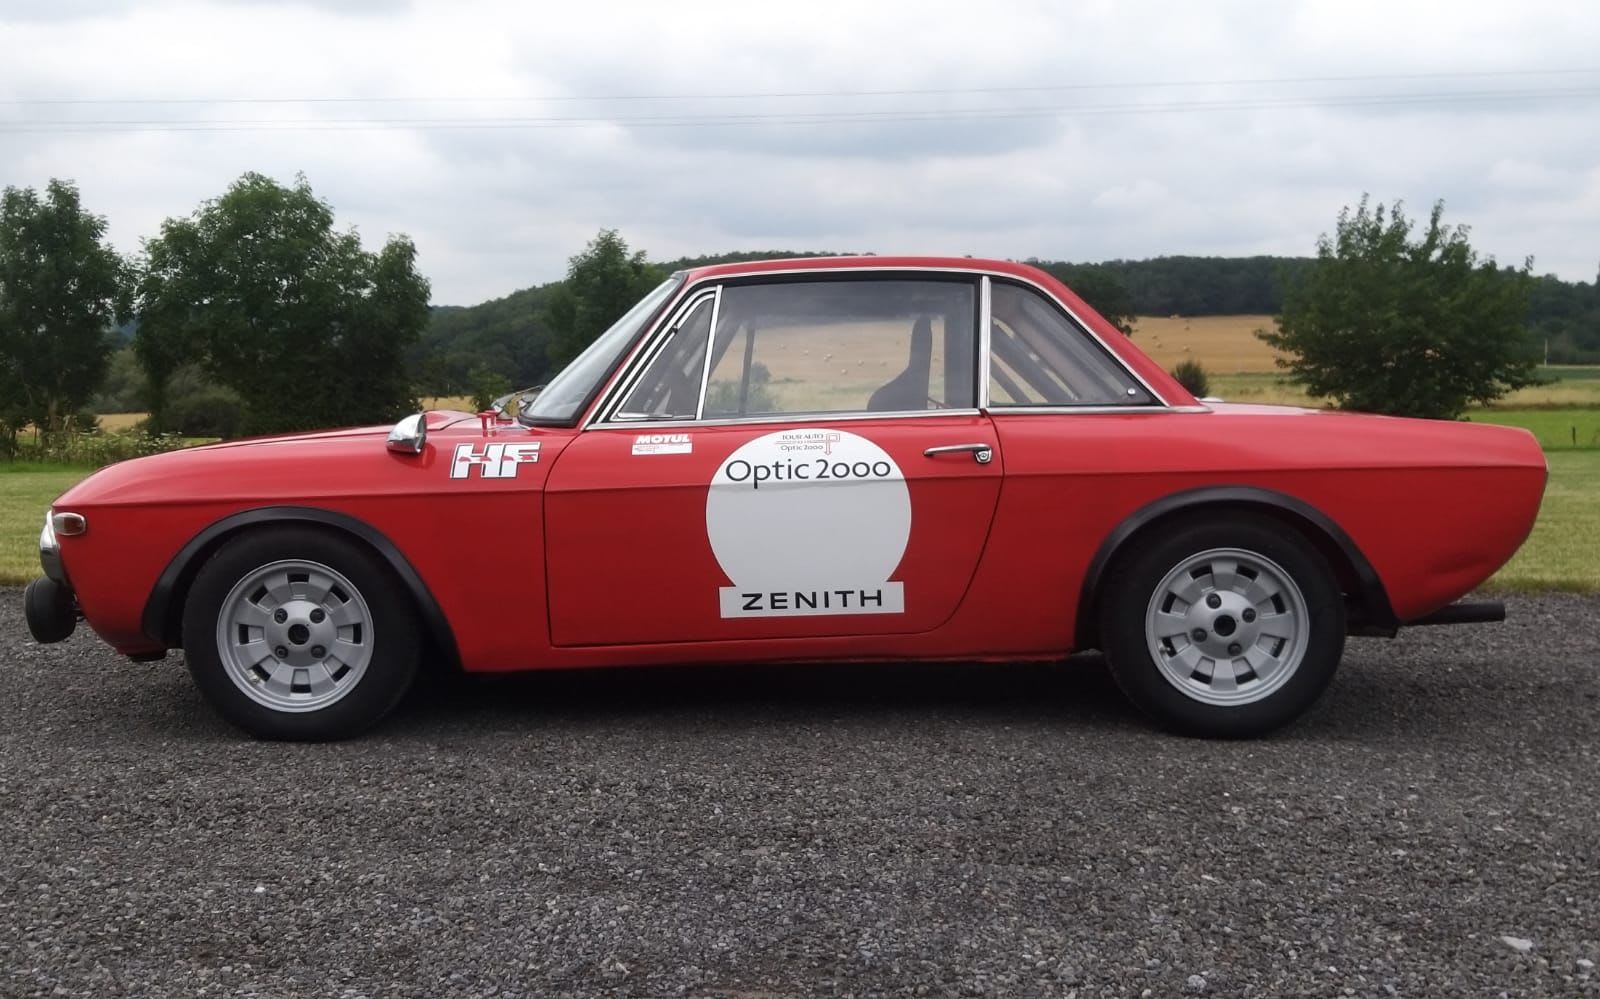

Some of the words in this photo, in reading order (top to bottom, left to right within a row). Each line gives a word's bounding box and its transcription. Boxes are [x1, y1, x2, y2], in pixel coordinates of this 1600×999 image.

[635, 433, 690, 445] MOTUL
[780, 444, 802, 452] Optic
[450, 441, 542, 479] HF
[725, 458, 810, 489] Optic
[815, 459, 891, 479] 2000
[741, 589, 882, 611] ZENITH
